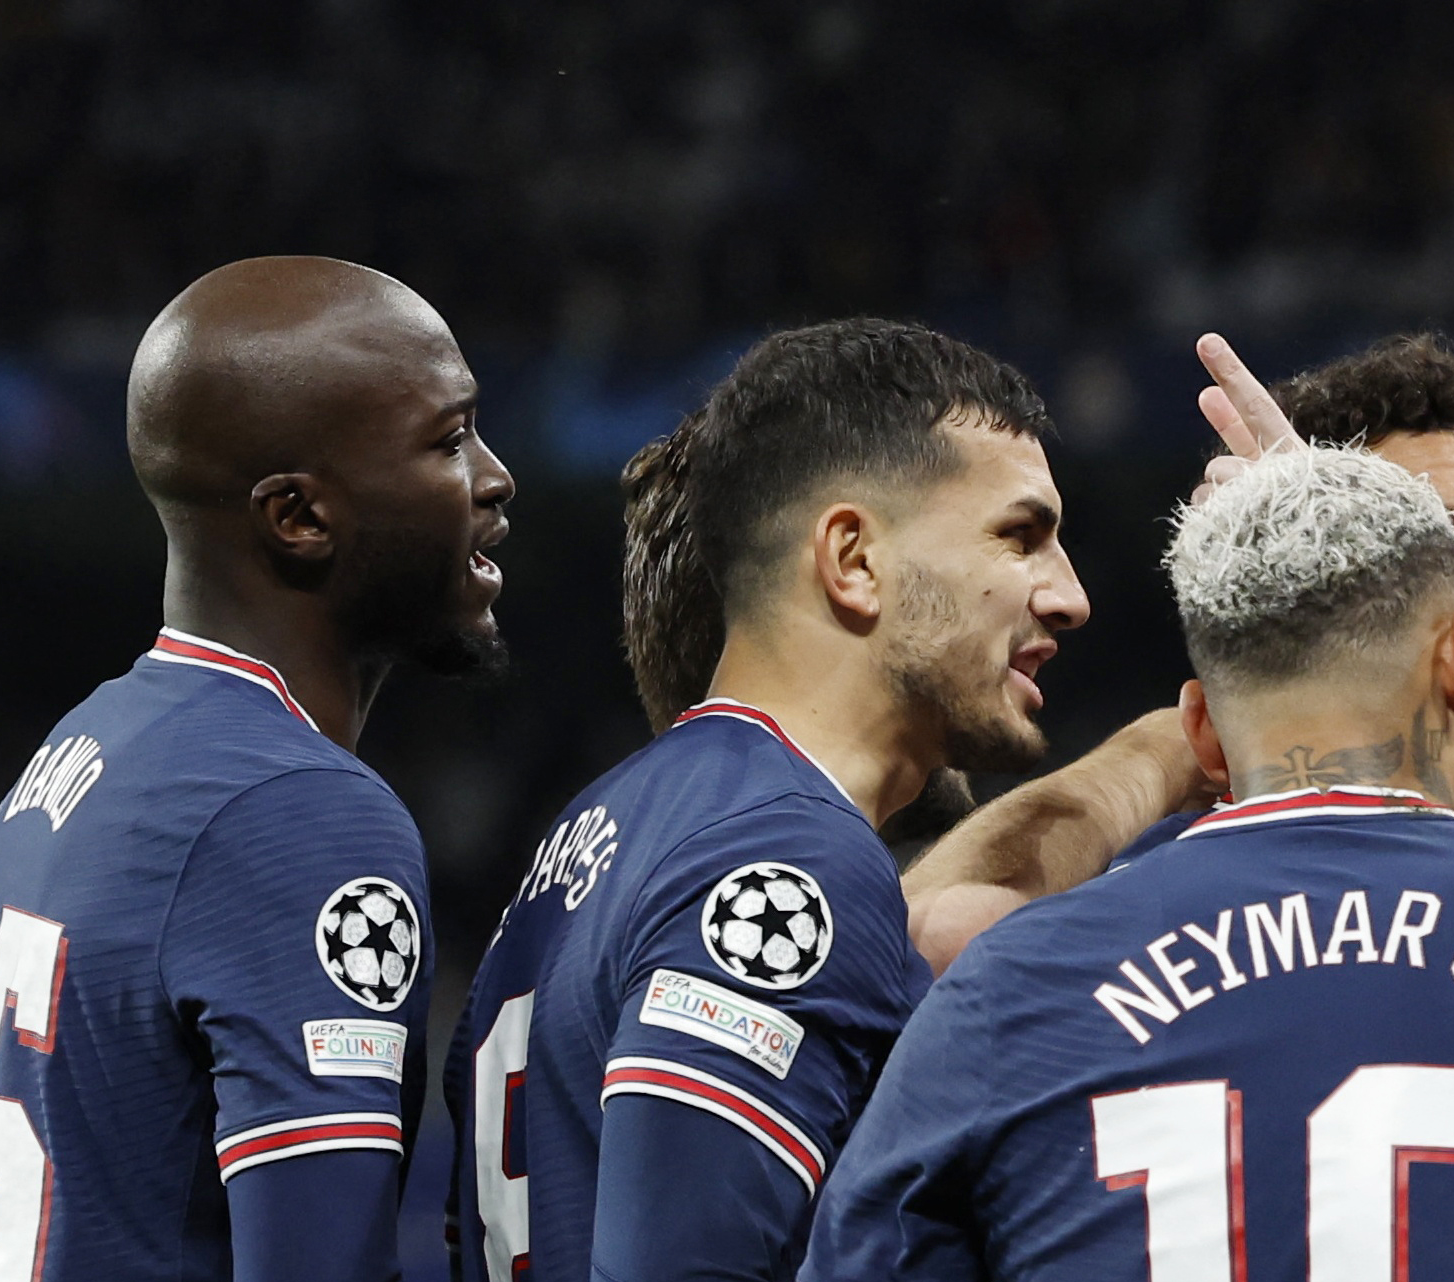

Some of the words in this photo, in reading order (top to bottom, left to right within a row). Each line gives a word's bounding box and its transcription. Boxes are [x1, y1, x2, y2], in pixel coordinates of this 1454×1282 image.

[3, 734, 104, 833] DANILO
[655, 972, 691, 989] UEFA
[1093, 889, 1442, 1045] NEYMAR
[310, 1023, 346, 1036] UEFA
